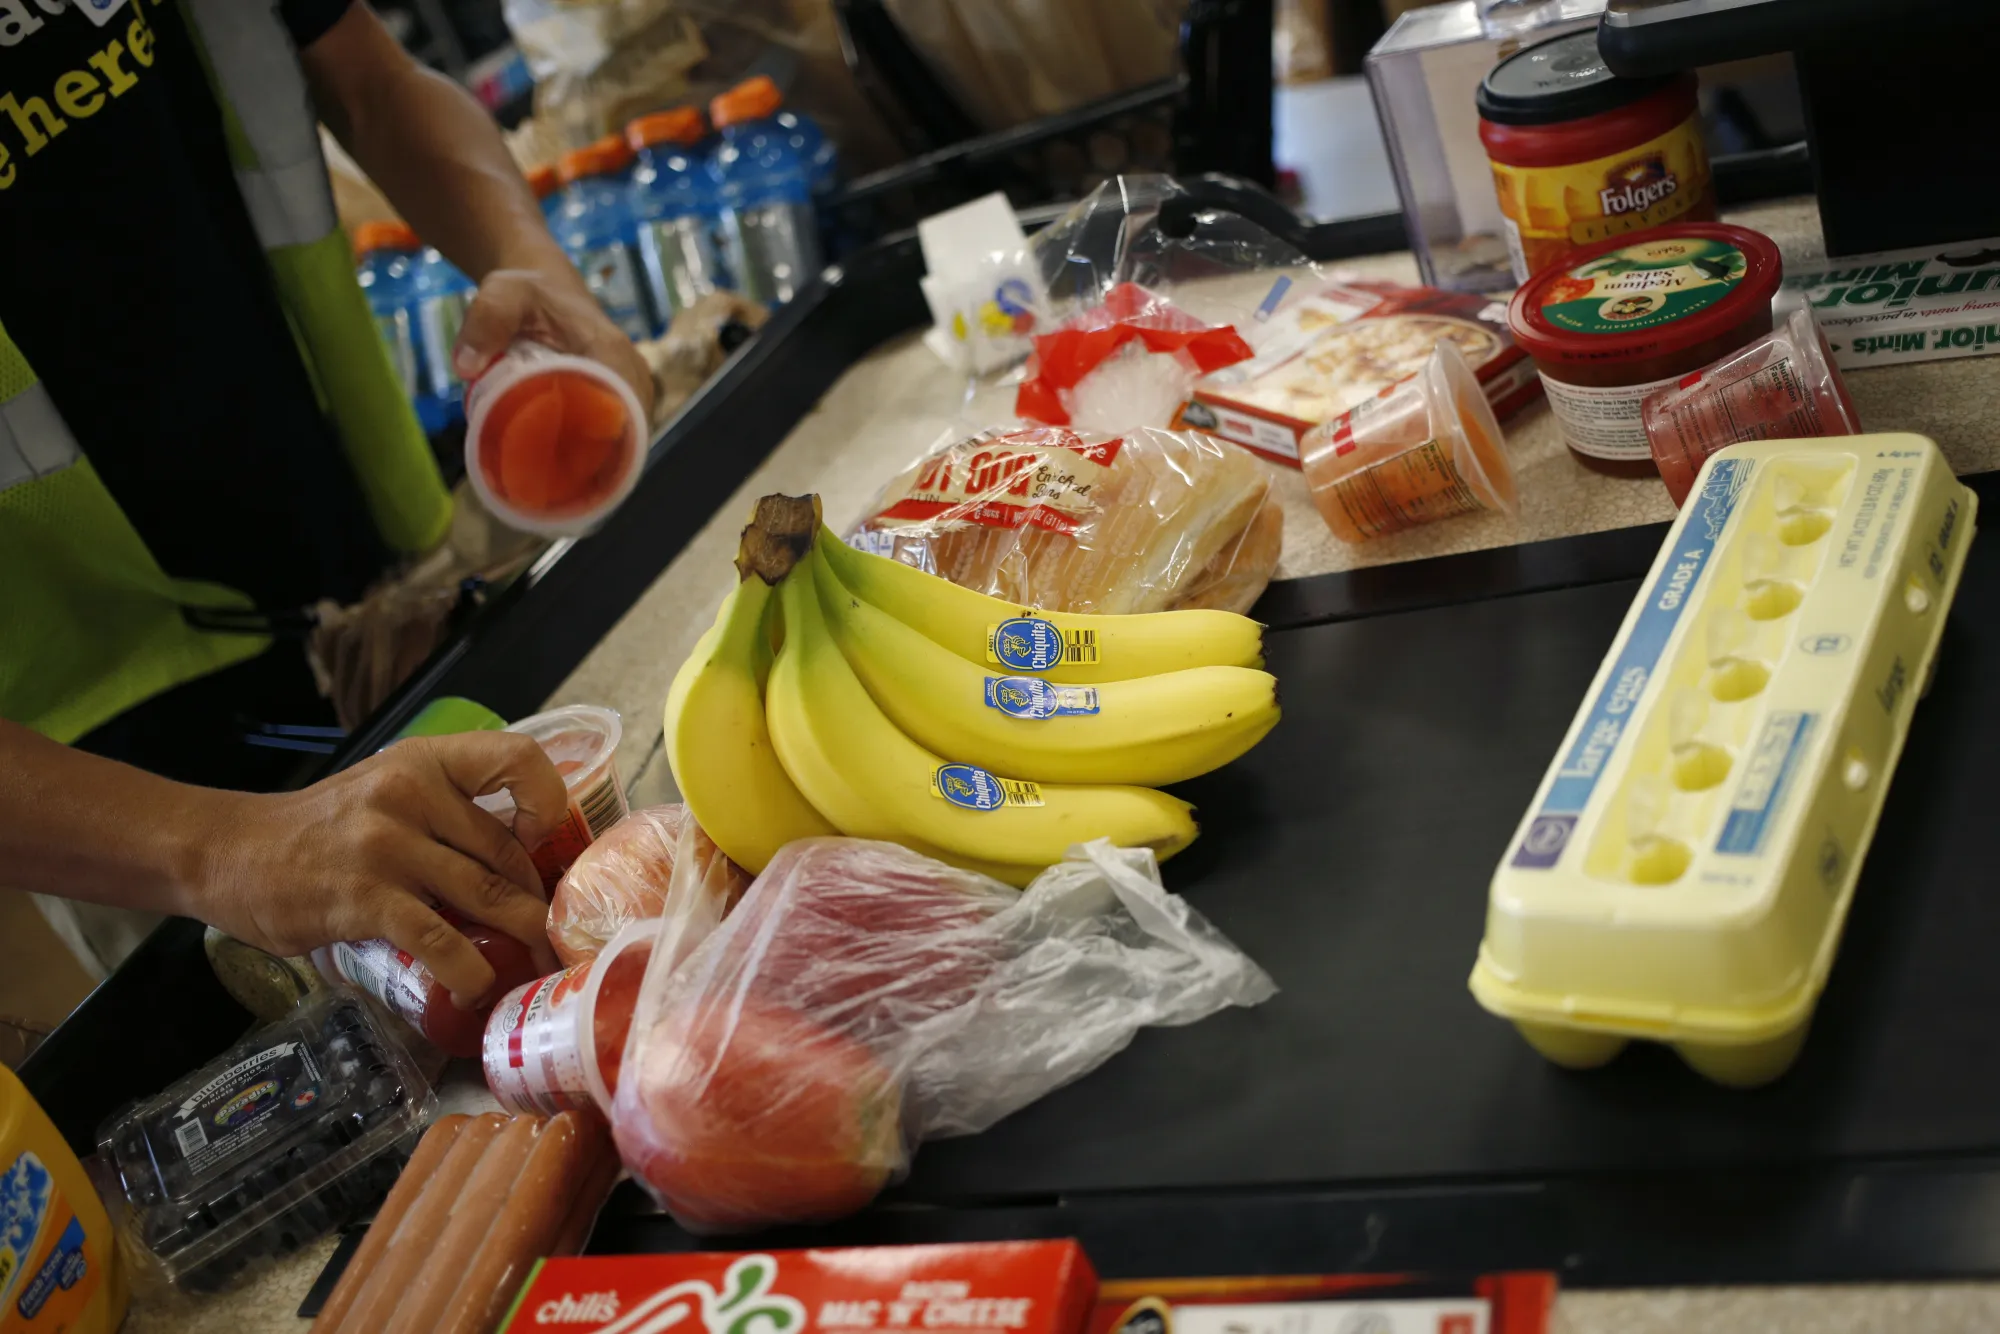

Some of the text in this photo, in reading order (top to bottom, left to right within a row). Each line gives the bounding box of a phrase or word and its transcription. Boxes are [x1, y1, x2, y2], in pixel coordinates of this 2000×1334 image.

[1600, 172, 1677, 216] Folgers
[1604, 277, 1687, 291] Medium
[1626, 269, 1675, 281] Salsa
[1782, 257, 1932, 291] Mints
[1865, 308, 1901, 323] pure
[1902, 310, 1918, 322] in
[1920, 306, 1960, 318] mints
[1852, 329, 1927, 356] Mints
[1769, 366, 1784, 392] Facts
[1777, 360, 1798, 404] Nutrition
[1658, 548, 1704, 611] GRADE A
[1031, 622, 1051, 669] Chiquita
[1048, 631, 1058, 660] Guatemala
[1029, 679, 1048, 718] Chiquita
[971, 769, 992, 809] Chiquita
[191, 1047, 278, 1104] blueberries
[202, 1087, 234, 1109] bleuets
[218, 1080, 276, 1118] Paradise
[535, 1289, 621, 1325] chili's
[817, 1300, 882, 1328] MAC
[922, 1297, 1033, 1329] CHEESE
